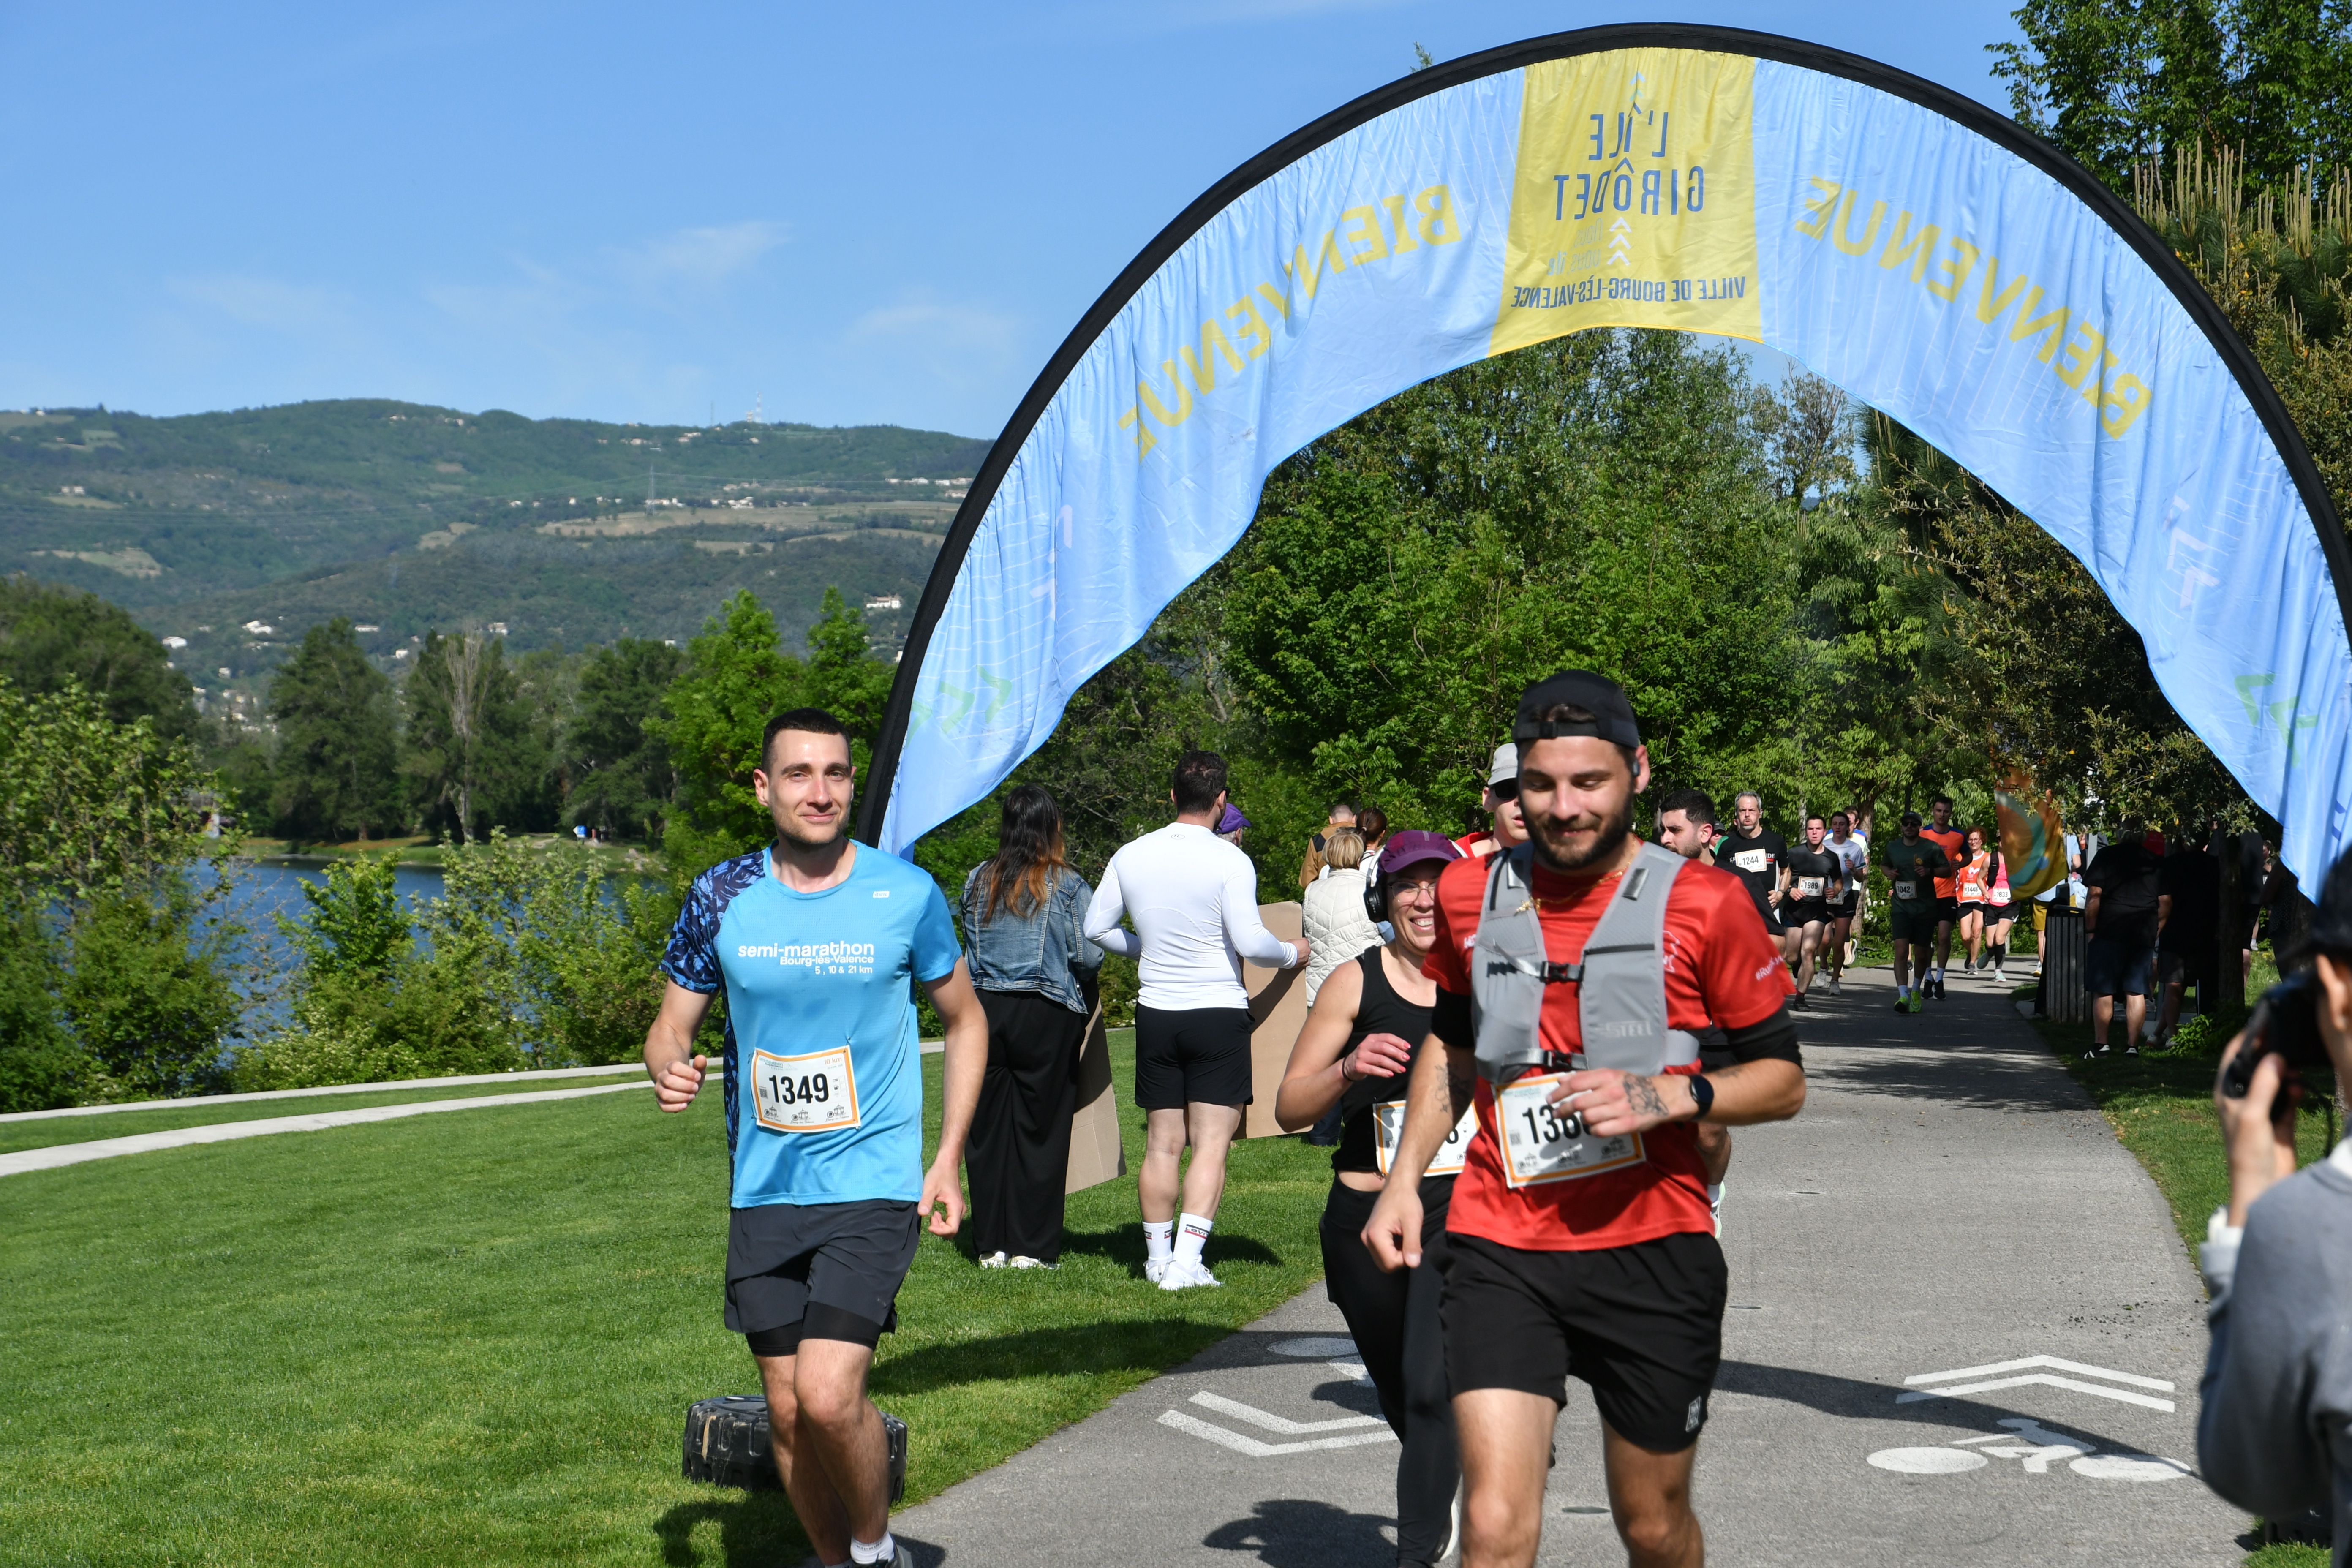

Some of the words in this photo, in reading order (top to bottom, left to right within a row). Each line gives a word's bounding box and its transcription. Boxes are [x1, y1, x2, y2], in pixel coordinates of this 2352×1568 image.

[1742, 856, 1759, 866] 1244
[738, 941, 874, 957] semi-marathon
[780, 955, 874, 966] Bourg-lès-Valence
[859, 966, 873, 974] km
[768, 1073, 829, 1105] 1349
[1522, 1105, 1591, 1144] 136
